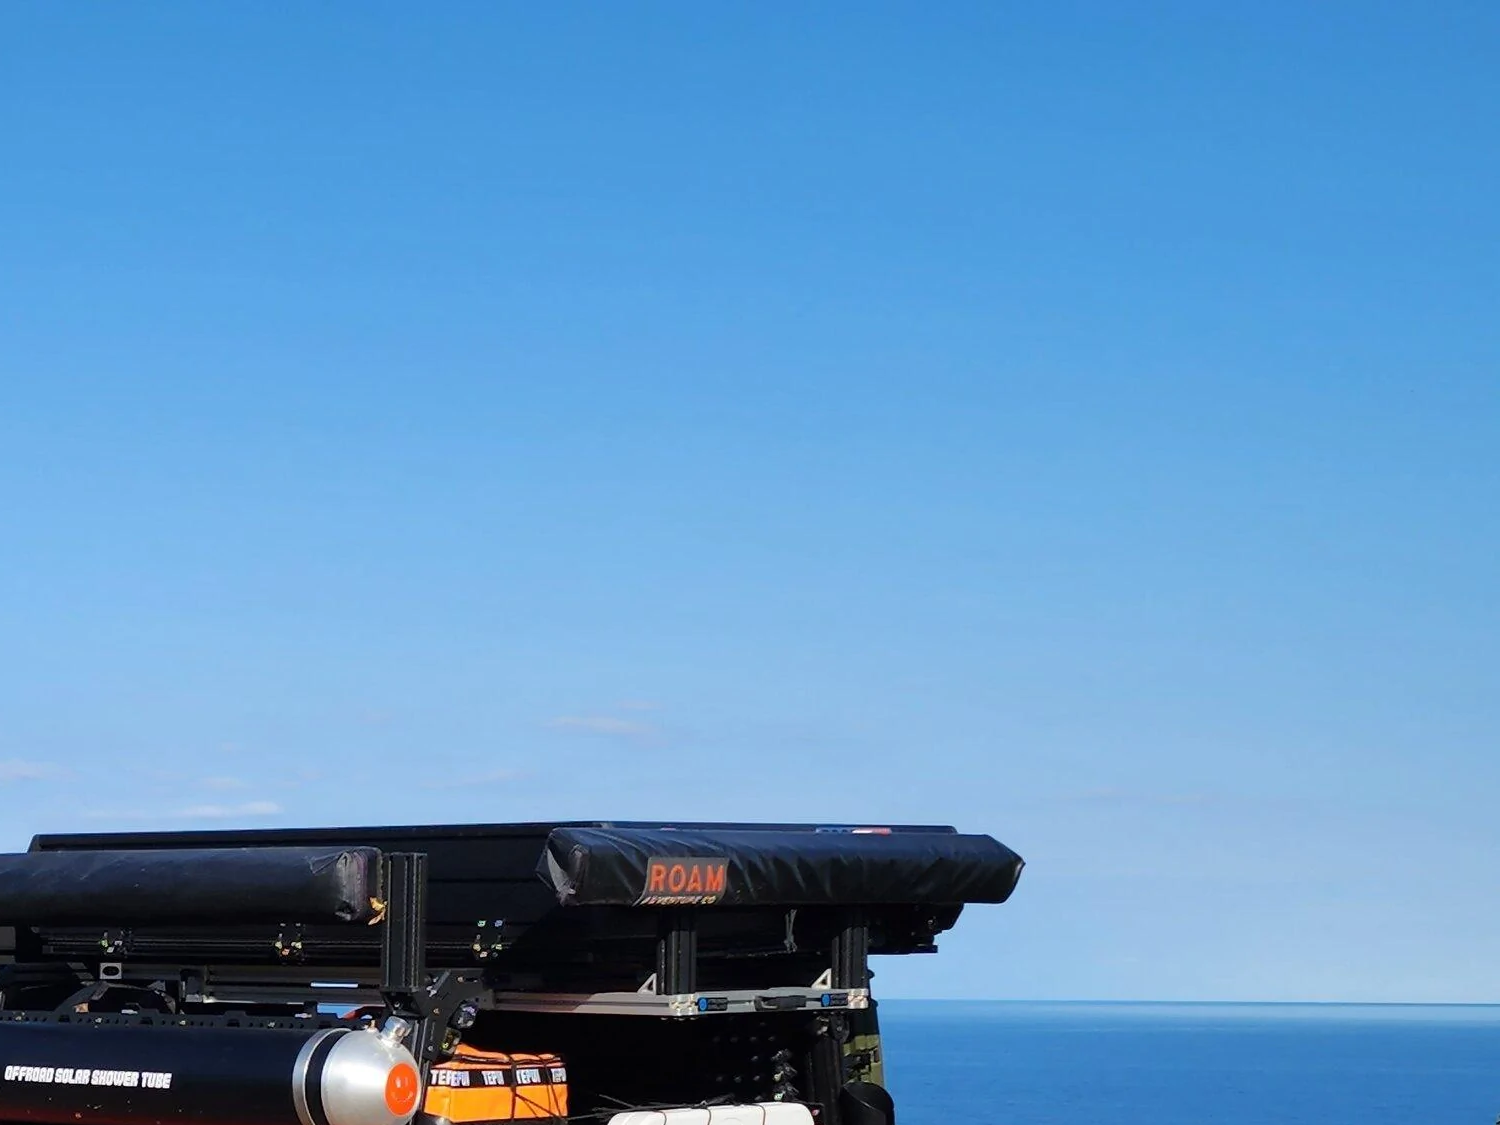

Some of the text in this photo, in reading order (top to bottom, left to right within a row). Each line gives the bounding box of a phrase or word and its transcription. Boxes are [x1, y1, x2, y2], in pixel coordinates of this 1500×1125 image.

[649, 864, 724, 892] ROAM
[4, 1065, 172, 1089] OFFROAD SOLAR SHOWER TUBE
